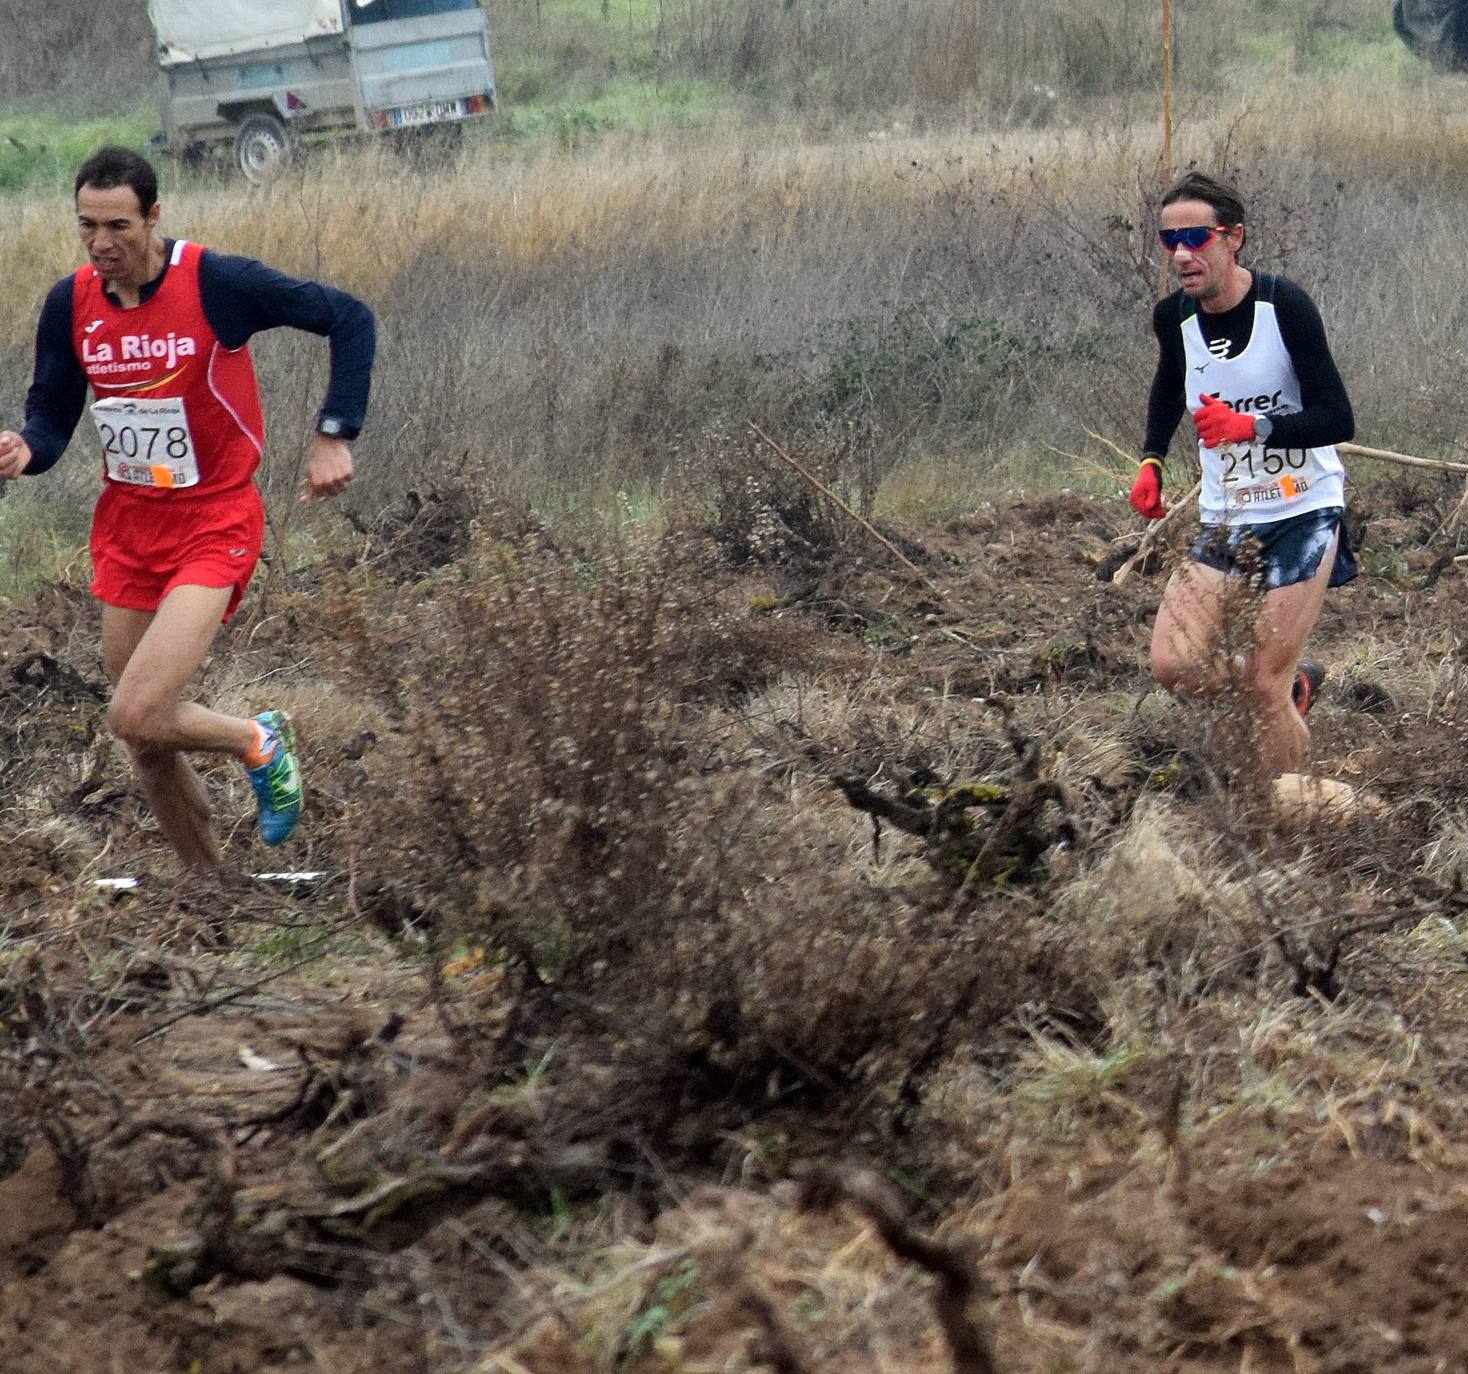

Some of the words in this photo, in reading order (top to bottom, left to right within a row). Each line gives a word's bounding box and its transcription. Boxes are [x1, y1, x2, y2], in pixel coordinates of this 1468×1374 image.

[82, 338, 113, 362] La
[121, 332, 196, 369] Rioja
[86, 361, 152, 375] atletismo
[100, 424, 188, 460] 2078
[1220, 447, 1307, 483] 2150
